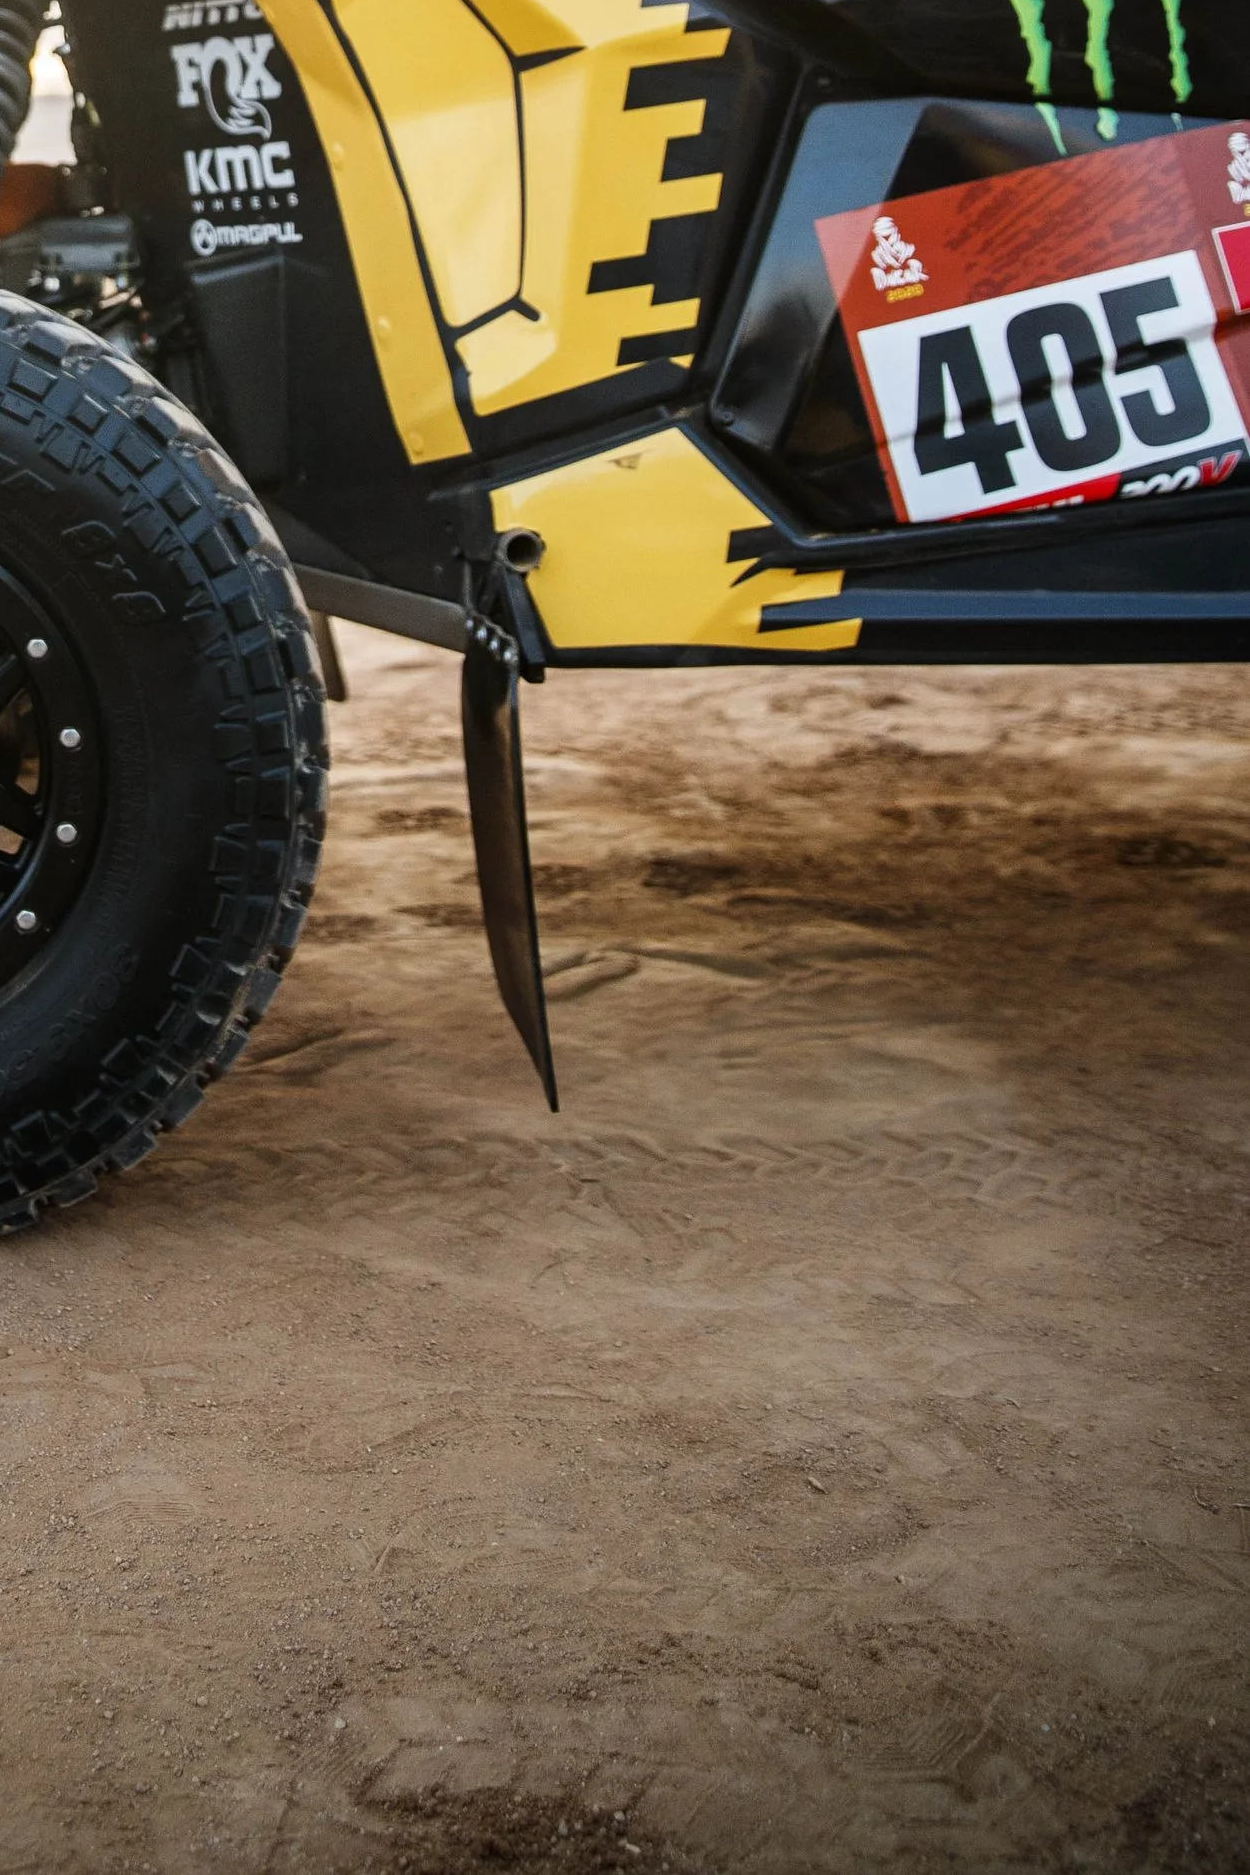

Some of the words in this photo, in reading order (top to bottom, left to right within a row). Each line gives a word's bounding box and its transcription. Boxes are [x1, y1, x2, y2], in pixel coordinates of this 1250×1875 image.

[170, 32, 283, 139] FOX
[192, 191, 299, 213] WHEELS
[214, 221, 304, 246] MAGPUL
[913, 276, 1212, 496] 405
